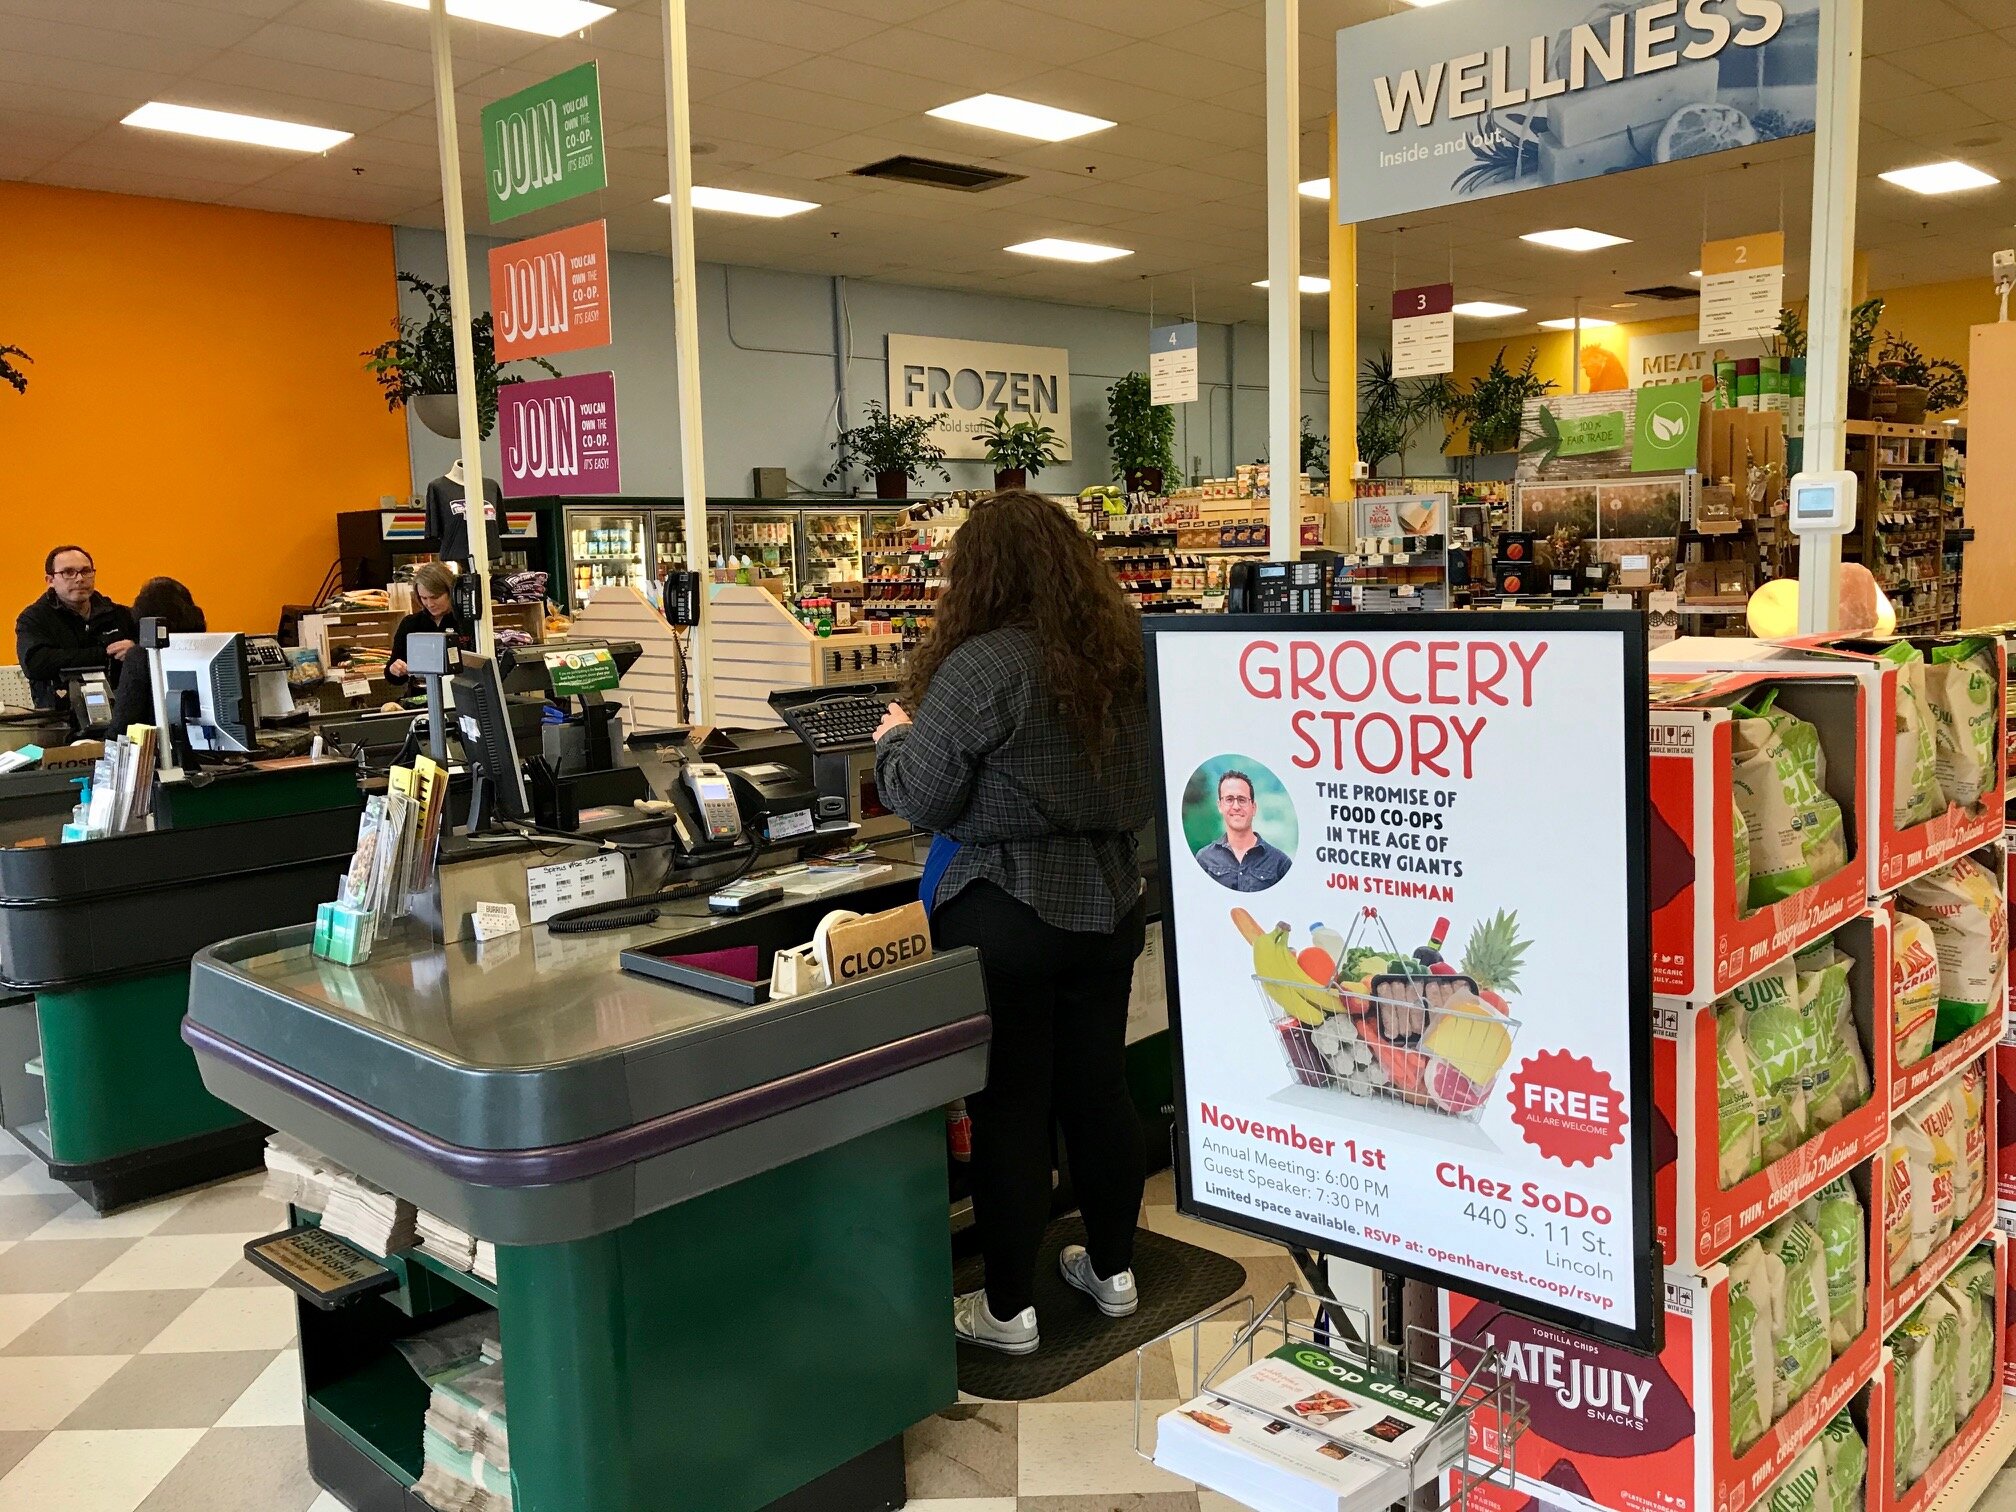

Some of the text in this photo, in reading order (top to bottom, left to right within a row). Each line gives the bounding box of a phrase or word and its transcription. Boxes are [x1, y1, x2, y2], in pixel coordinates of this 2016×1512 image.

[1373, 0, 1784, 133] WELLNESS
[562, 95, 588, 116] YOU CAN
[564, 113, 591, 132] OWN THE
[493, 99, 563, 201] JOIN
[565, 129, 593, 149] CO-OP.
[1380, 126, 1506, 168] Inside and out.
[567, 152, 594, 172] IT'S EASY!
[570, 253, 596, 269] YOU CAN
[1735, 246, 1747, 264] 2
[572, 269, 597, 285] OWN THE
[500, 251, 569, 343] JOIN
[572, 286, 599, 302] CO-OP.
[1417, 294, 1427, 310] 3
[573, 309, 599, 325] IT'S EASY!
[1169, 332, 1177, 345] 4
[1643, 351, 1706, 375] MEAT
[903, 365, 1058, 414] FROZEN
[580, 402, 606, 415] YOU CAN
[509, 396, 578, 479] JOIN
[581, 418, 607, 431] OWN THE
[940, 420, 961, 433] cold
[1567, 430, 1614, 445] FAIR TRADE
[583, 434, 609, 448] CO-OP.
[583, 457, 609, 470] IT'S EASY!
[1238, 640, 1548, 707] GROCERY
[1290, 710, 1487, 779] STORY
[47, 757, 104, 770] CLOSE
[1315, 781, 1457, 808] THE PROMISE OF
[1330, 804, 1443, 830] FOOD CO-OPS
[1326, 826, 1448, 852] IN THE AGE OF
[1316, 846, 1463, 878] GROCERY GIANTS
[1326, 873, 1454, 903] JON STEINMAN
[1750, 938, 1769, 964] THIN,
[1772, 926, 1797, 951] CRISPY
[1811, 897, 1844, 928] Delicious
[839, 934, 927, 979] CLOSED
[1903, 963, 1938, 992] CRISPY
[1665, 1030, 1678, 1038] CARE
[1524, 1082, 1610, 1124] FREE
[1200, 1102, 1387, 1171] November 1st
[1526, 1113, 1608, 1136] ALL ARE WELCOME
[1202, 1136, 1389, 1199] Annual Meeting: 6:00 PM
[1203, 1158, 1380, 1218] Guest Speaker: 7:30 PM
[1436, 1162, 1612, 1225] Chez SoDo
[1739, 1138, 1858, 1229] THIN, CRISPY and Delicious
[1463, 1202, 1612, 1257] 440 S. 11 St.
[1205, 1181, 1613, 1310] Limited space available. RSVP at: openharvest.coop/rsvp
[1546, 1249, 1613, 1282] Lincoln
[1667, 1303, 1693, 1315] WITH CARE
[1532, 1327, 1599, 1355] TORTILLA CHIPS
[1485, 1331, 1653, 1421] LATE JULY
[1369, 1382, 1446, 1416] deals
[1587, 1409, 1644, 1431] SNACKS
